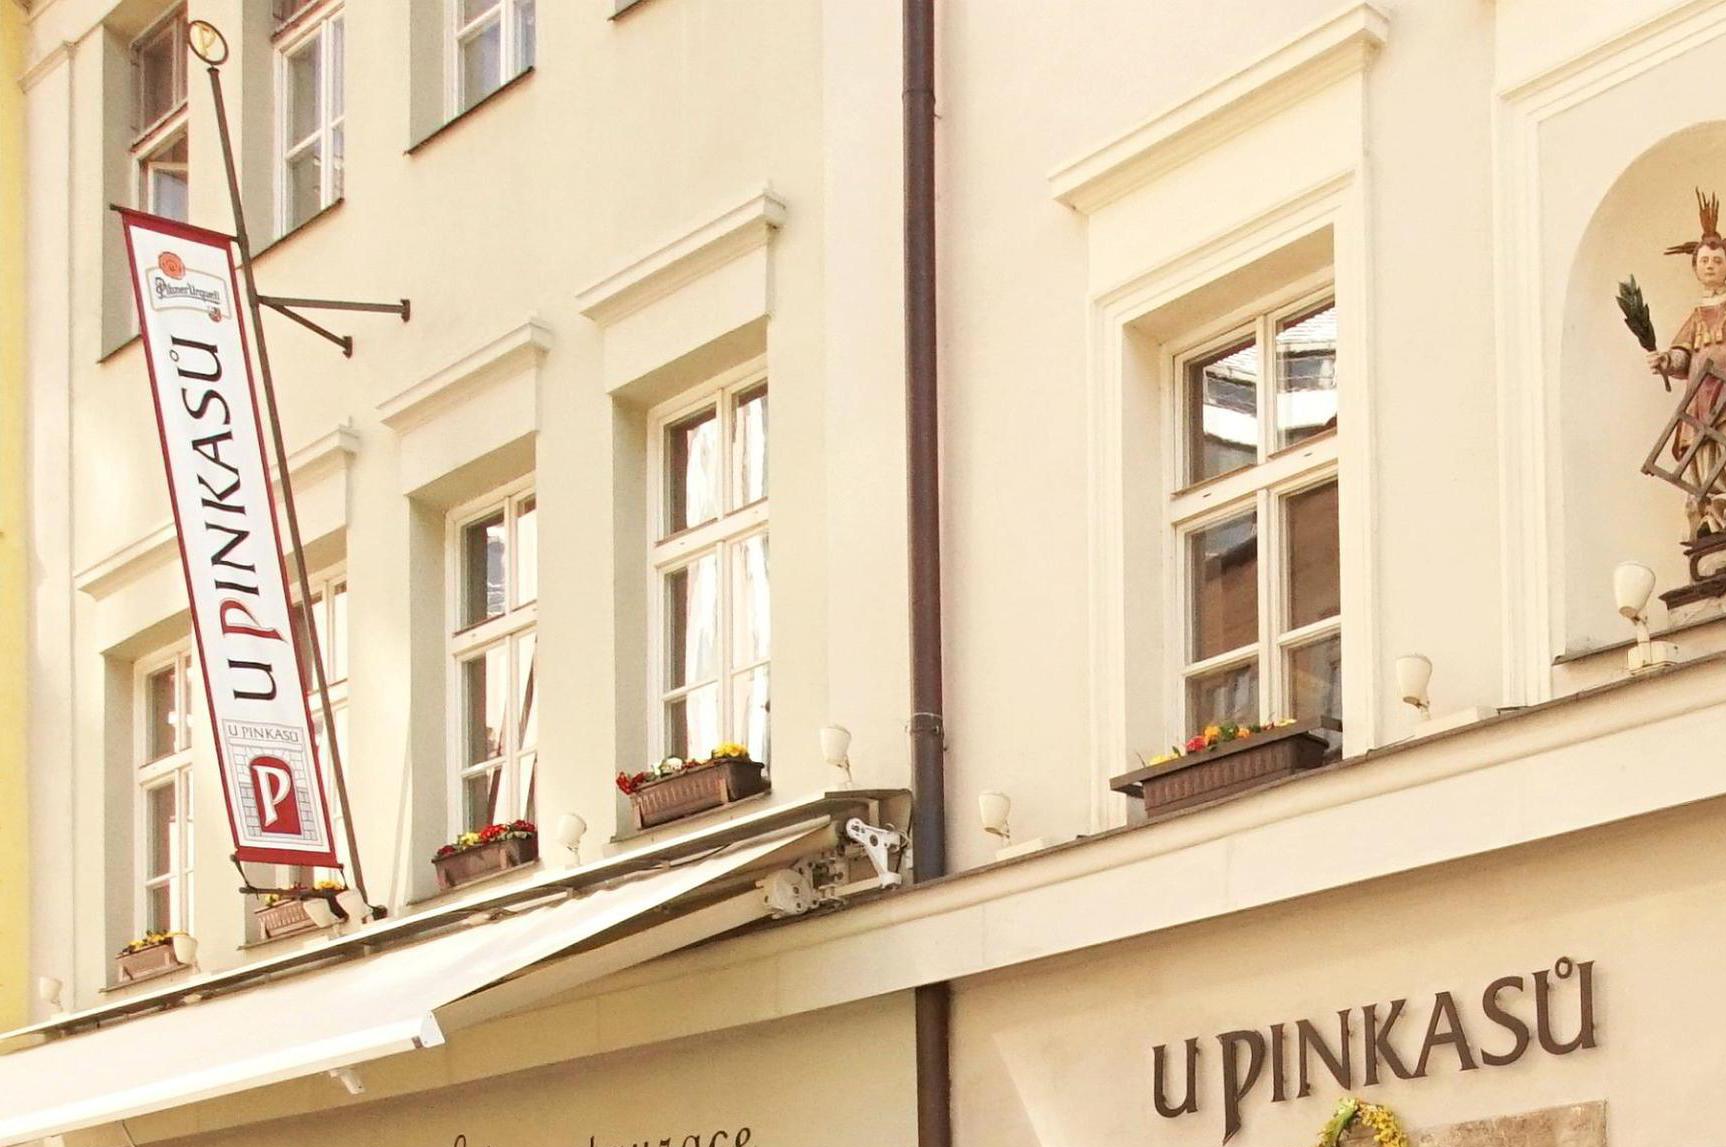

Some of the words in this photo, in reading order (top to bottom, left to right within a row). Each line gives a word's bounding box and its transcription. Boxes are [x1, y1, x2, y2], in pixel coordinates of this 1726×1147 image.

[169, 335, 290, 644] PINKASŮ
[228, 658, 278, 701] U
[228, 724, 239, 737] U
[251, 764, 292, 829] P
[1152, 1036, 1198, 1119] U
[1215, 956, 1597, 1146] PINKASŮ
